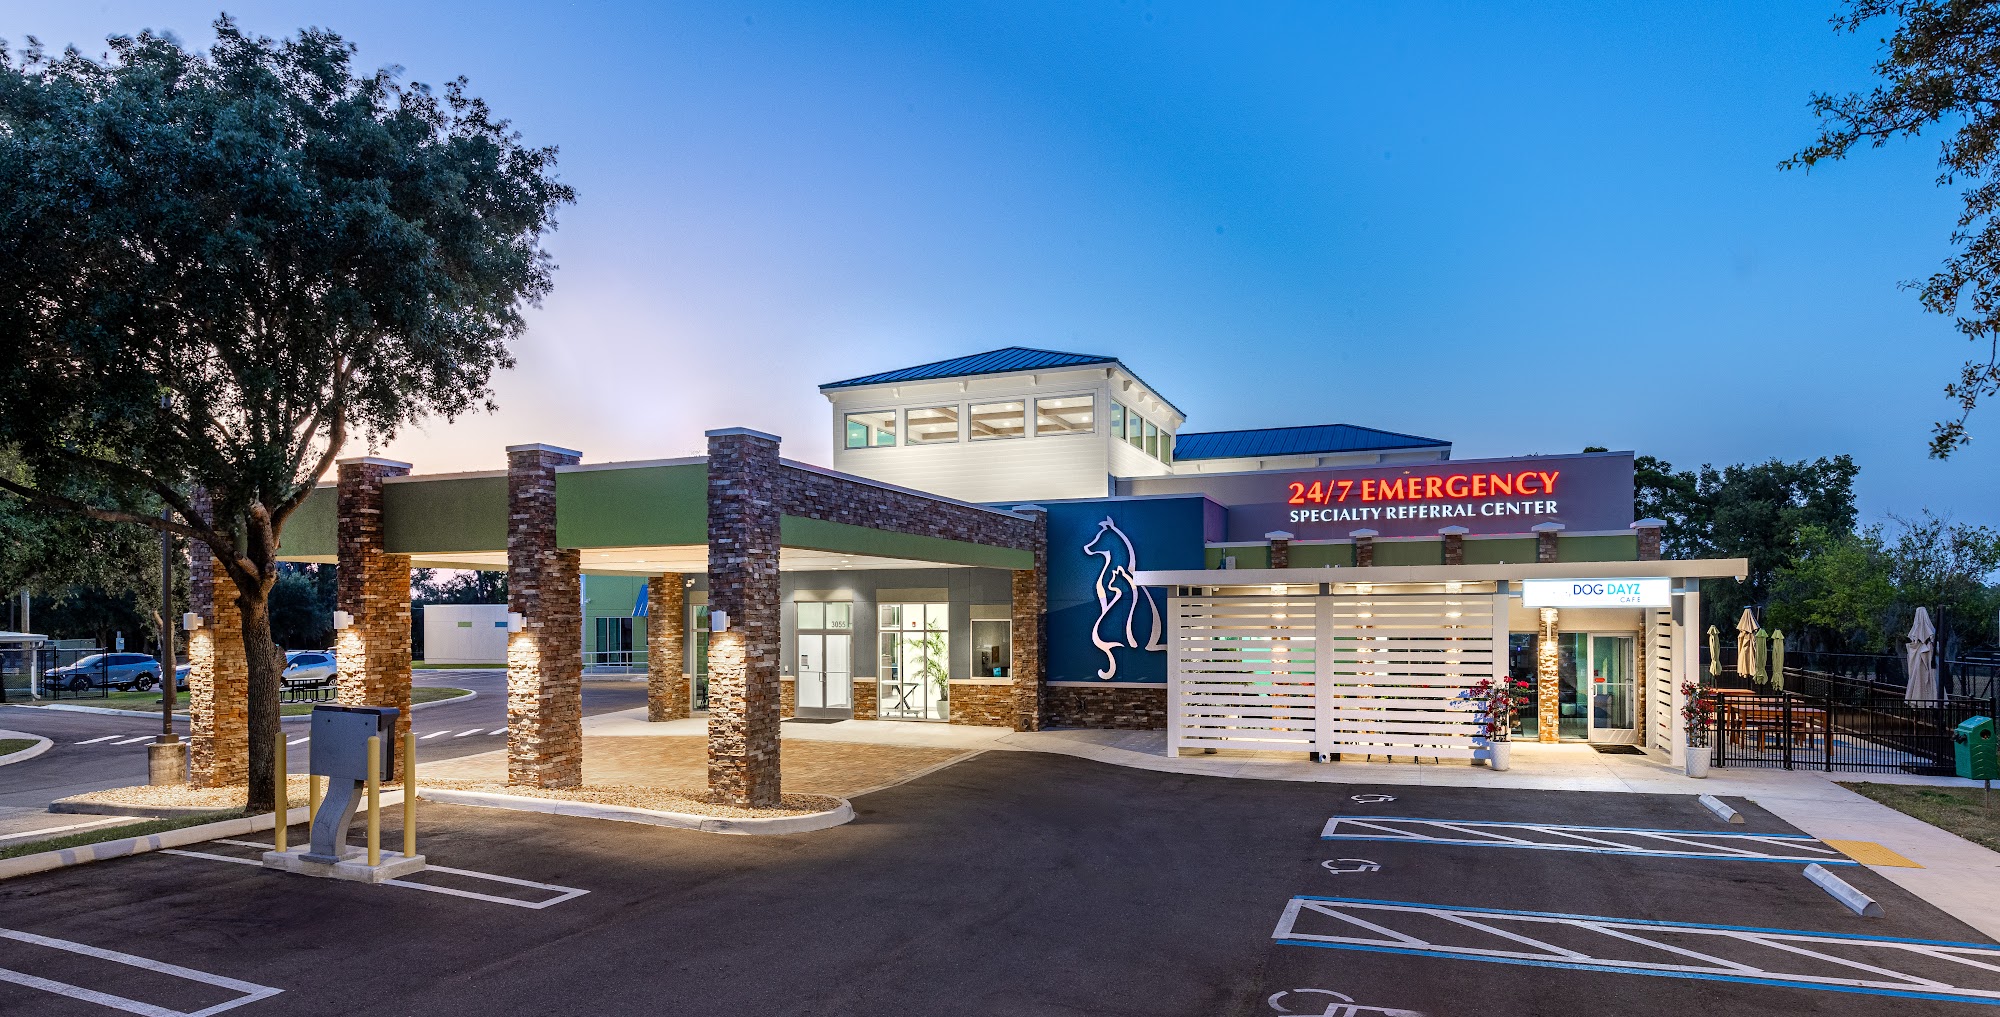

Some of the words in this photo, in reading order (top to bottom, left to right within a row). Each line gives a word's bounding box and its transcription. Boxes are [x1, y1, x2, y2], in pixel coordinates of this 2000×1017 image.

[1288, 479, 1354, 505] 24/7
[1361, 471, 1560, 501] EMERGENCY
[1290, 507, 1382, 523] SPECIALTY
[1386, 503, 1475, 520] REFERRAL
[1480, 500, 1558, 516] CENTER
[1573, 584, 1604, 595] DOG
[1607, 583, 1640, 595] DAYZ
